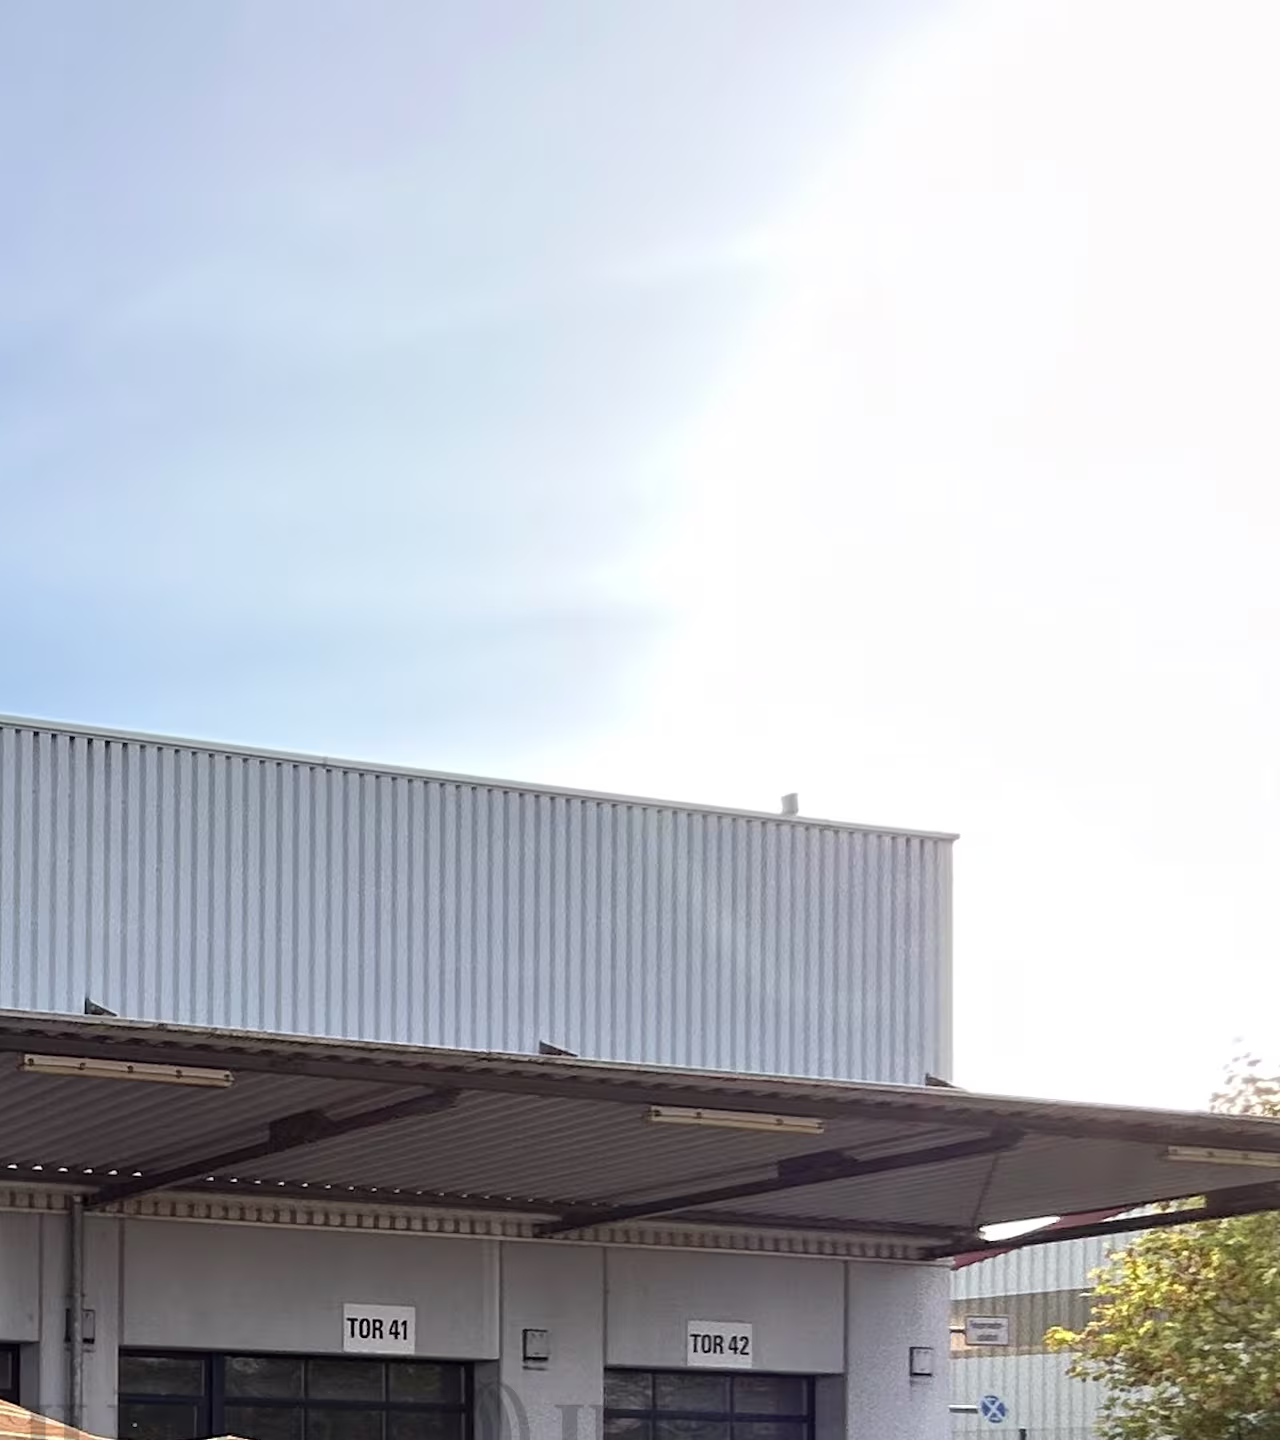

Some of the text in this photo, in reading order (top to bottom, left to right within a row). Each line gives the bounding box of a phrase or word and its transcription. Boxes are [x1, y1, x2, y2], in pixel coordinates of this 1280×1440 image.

[346, 1317, 408, 1341] TOR 41
[689, 1333, 750, 1355] TOR 42
